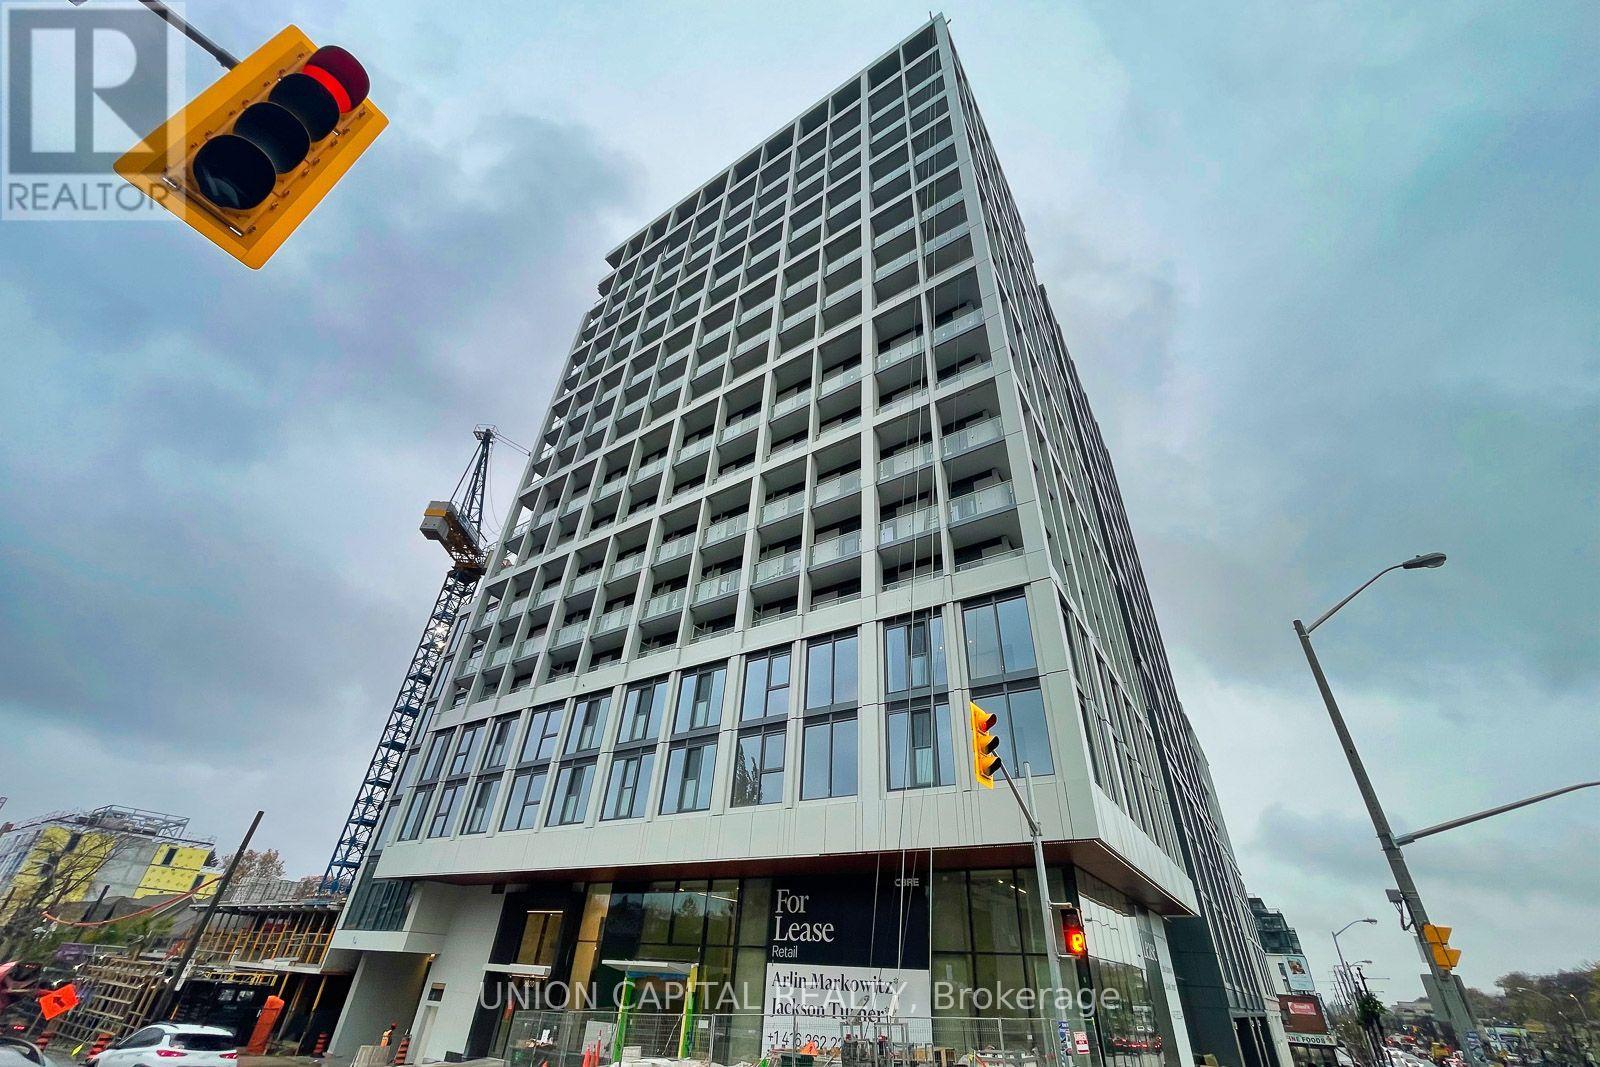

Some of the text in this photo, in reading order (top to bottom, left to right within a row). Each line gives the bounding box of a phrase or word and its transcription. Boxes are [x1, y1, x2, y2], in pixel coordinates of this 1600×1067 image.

[894, 877, 920, 887] CBRE
[775, 888, 810, 914] For
[773, 915, 835, 943] Lease
[771, 945, 798, 958] Retail
[771, 970, 807, 989] Arlin
[771, 998, 825, 1018] Jackson
